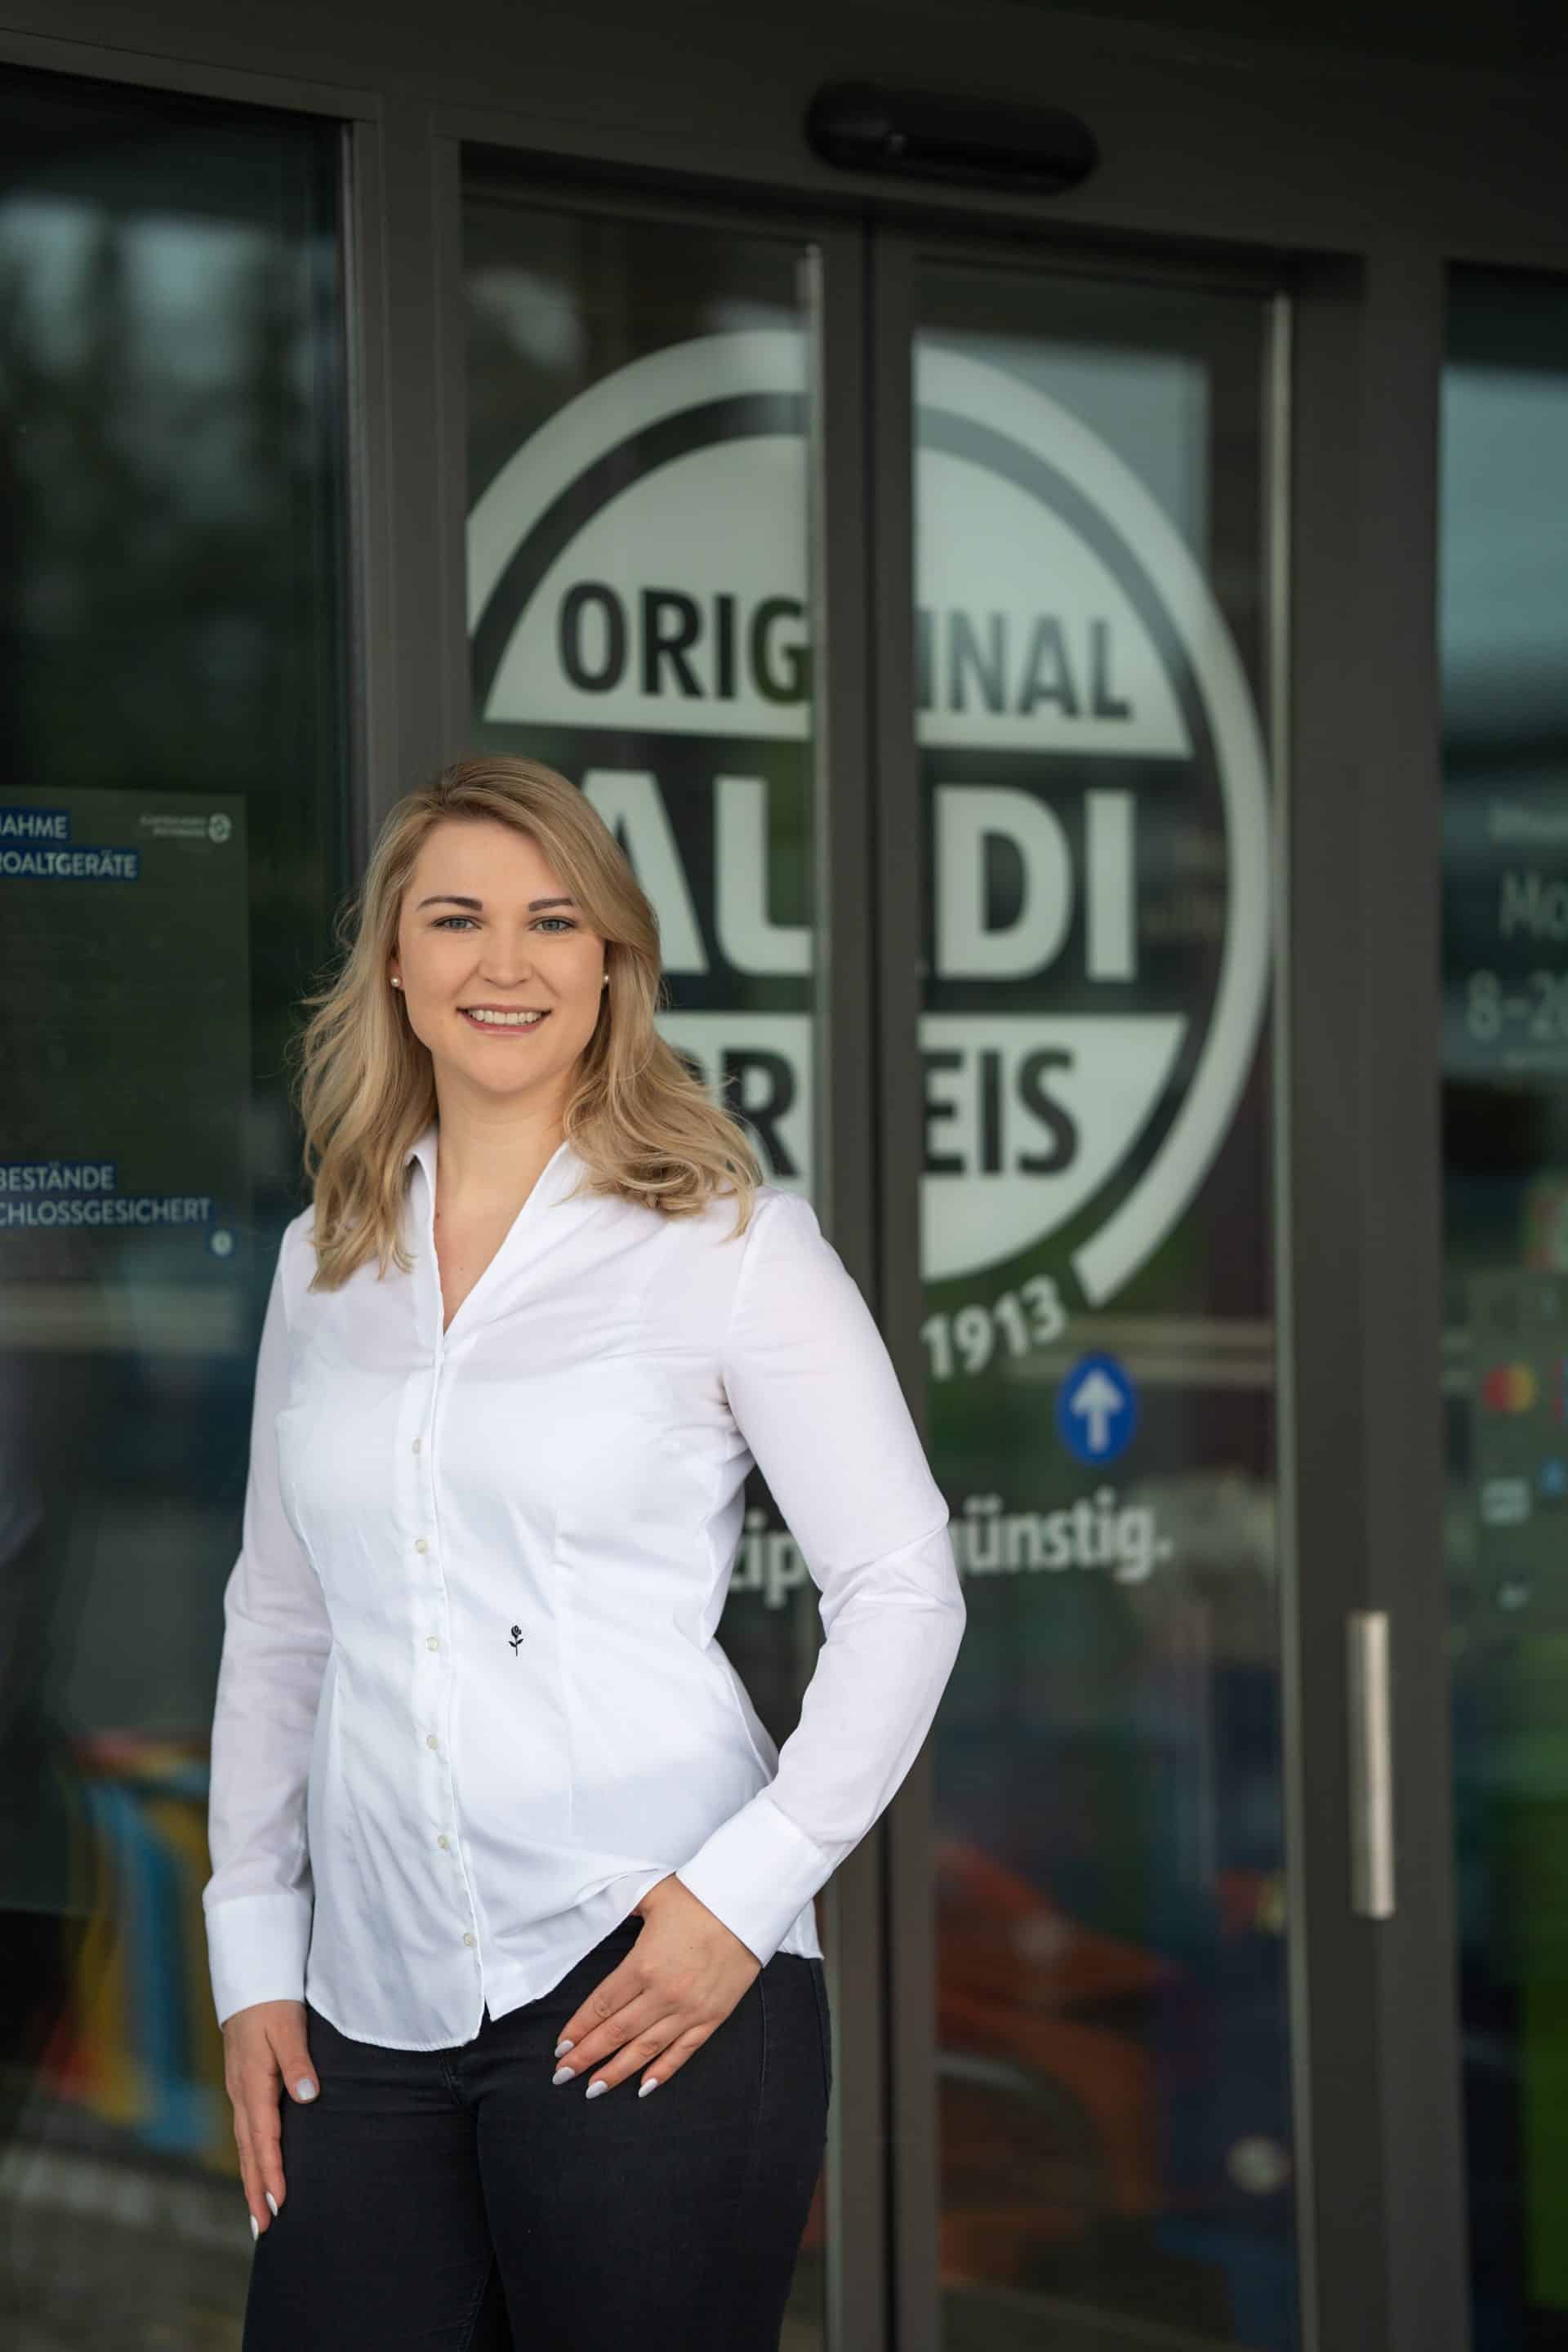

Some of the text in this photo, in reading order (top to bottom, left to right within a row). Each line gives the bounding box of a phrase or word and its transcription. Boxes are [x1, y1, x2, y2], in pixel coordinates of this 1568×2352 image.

[0, 813, 68, 839] AHME
[0, 850, 137, 879] OALTGERÄTE
[672, 1045, 1082, 1178] REIS
[921, 1274, 1067, 1379] 1913
[947, 1486, 1174, 1582] ünstig.
